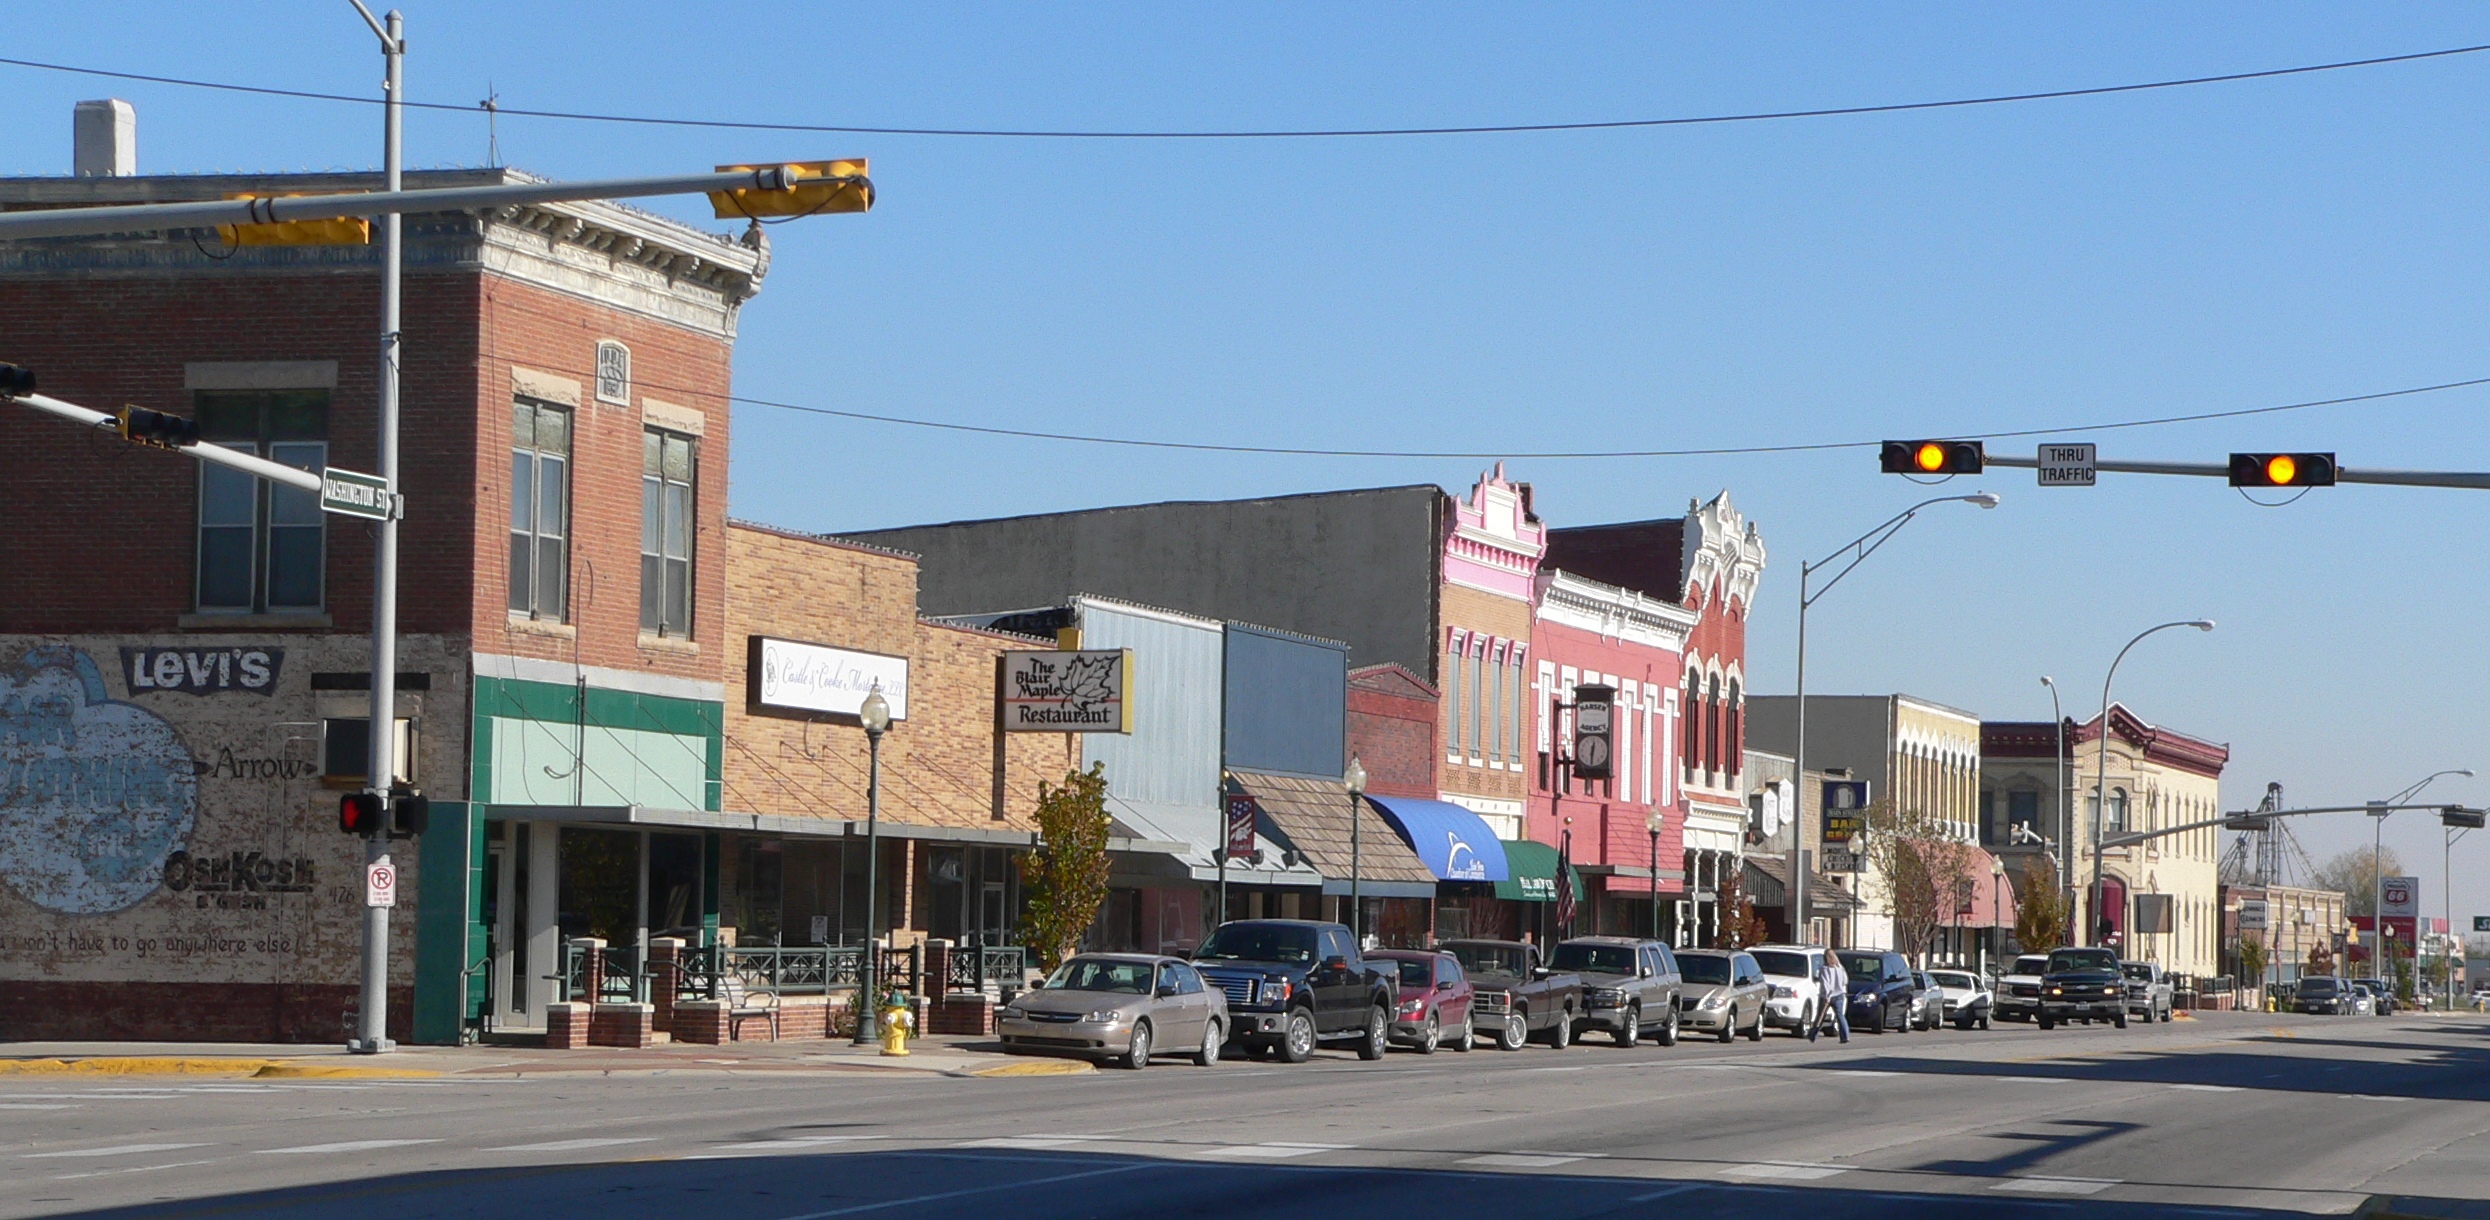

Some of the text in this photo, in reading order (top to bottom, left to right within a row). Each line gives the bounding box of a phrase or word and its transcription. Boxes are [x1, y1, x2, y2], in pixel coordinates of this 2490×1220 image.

[2049, 448, 2085, 461] THRU
[2041, 467, 2093, 481] TRAFFIC
[325, 478, 387, 510] WASHINGTON ST
[782, 655, 811, 685] Castle
[818, 659, 844, 690] Cooke
[843, 669, 886, 693] Mortgge
[1029, 657, 1056, 674] The
[1015, 671, 1052, 685] Blair
[1017, 684, 1061, 700] Maple
[1017, 704, 1112, 724] Restaurant
[211, 747, 302, 780] Arrow
[2387, 890, 2406, 901] 66
[69, 932, 105, 952] have
[111, 935, 129, 952] to
[136, 939, 157, 958] go
[166, 934, 248, 957] anywhere
